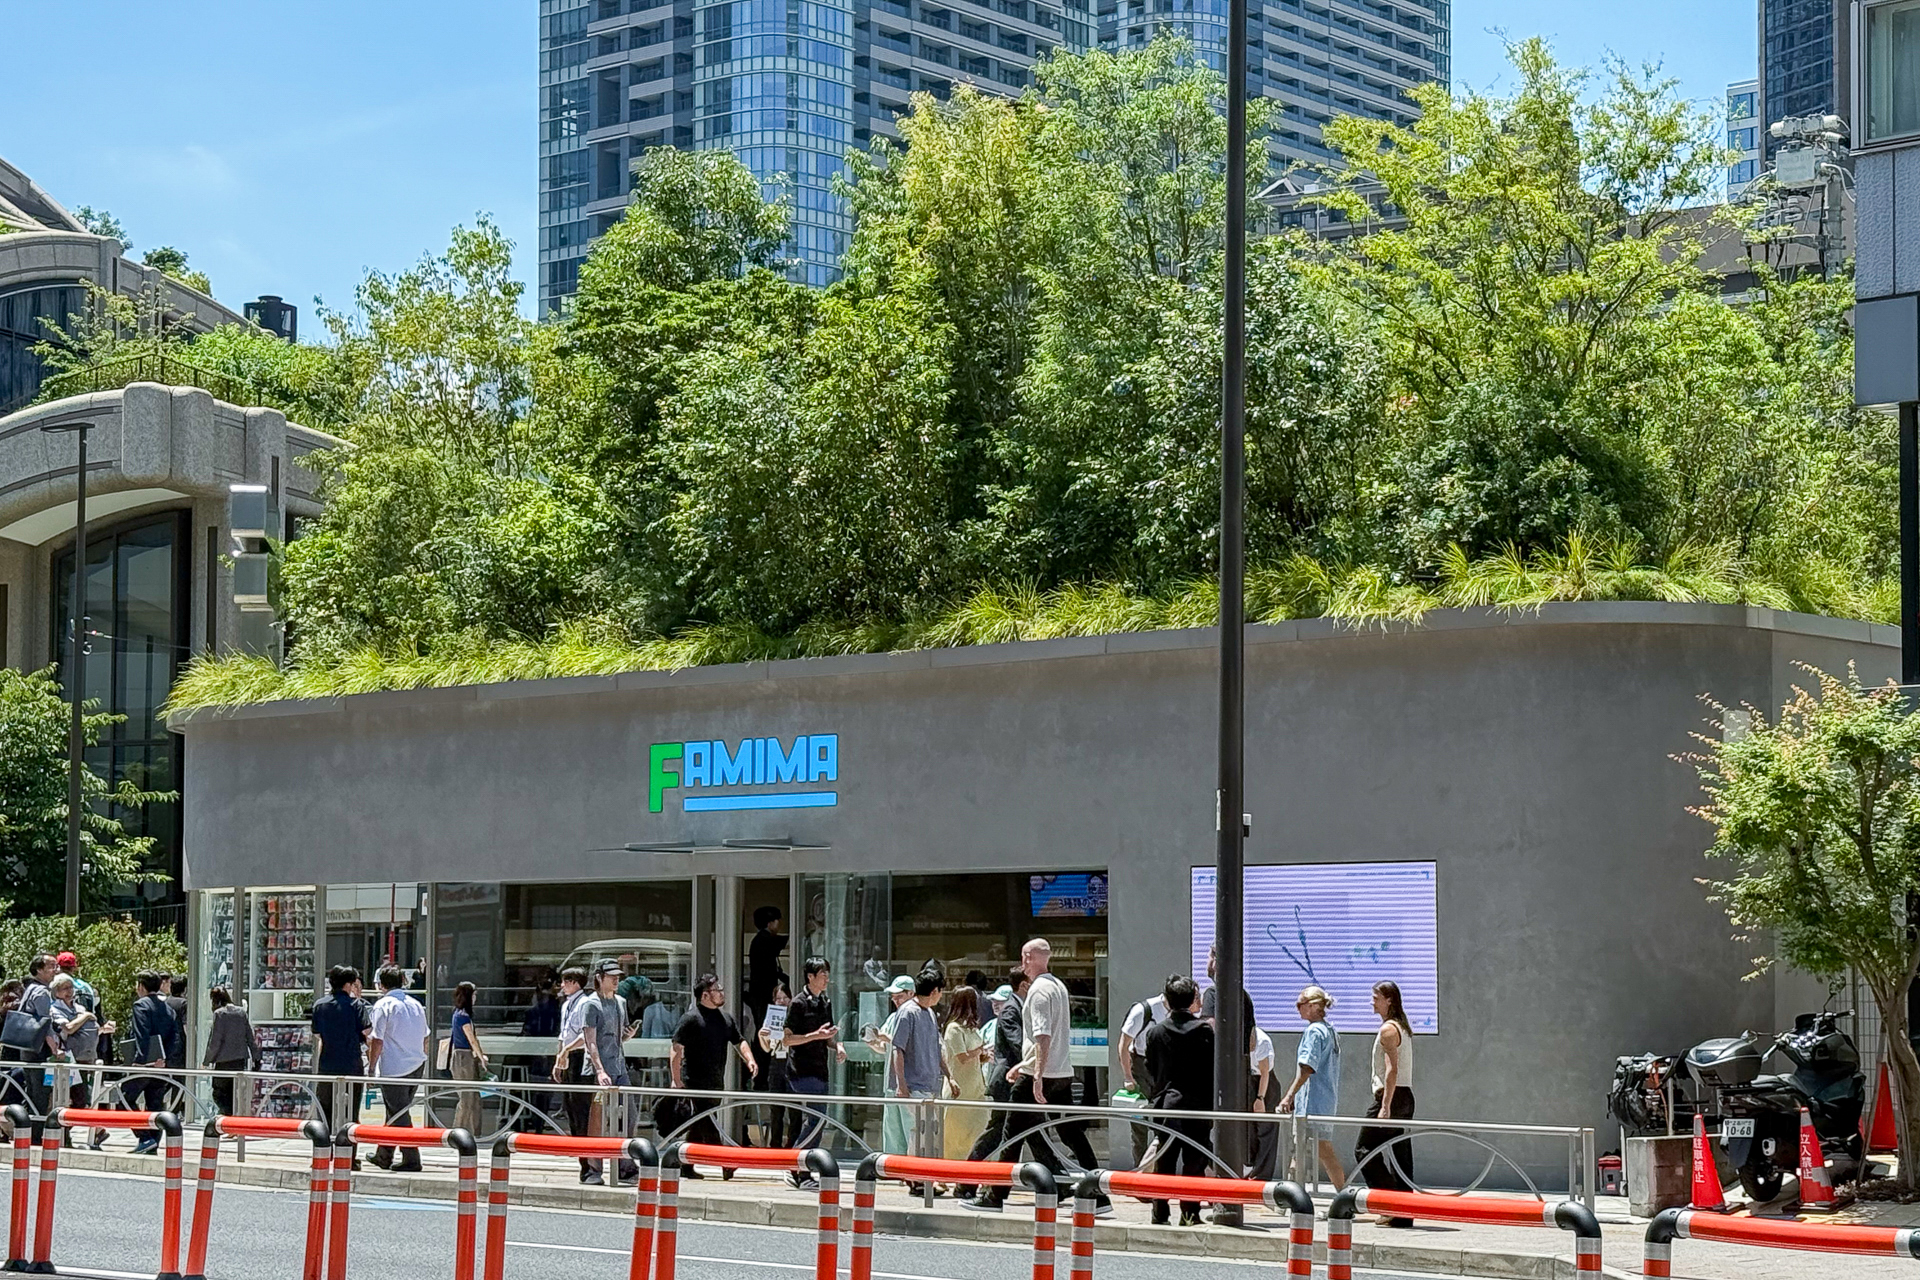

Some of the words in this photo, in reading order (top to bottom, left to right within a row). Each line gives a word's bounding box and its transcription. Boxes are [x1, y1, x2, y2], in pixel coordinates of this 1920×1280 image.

[649, 733, 838, 813] FAMIMA
[1800, 1133, 1813, 1180] 立入禁止
